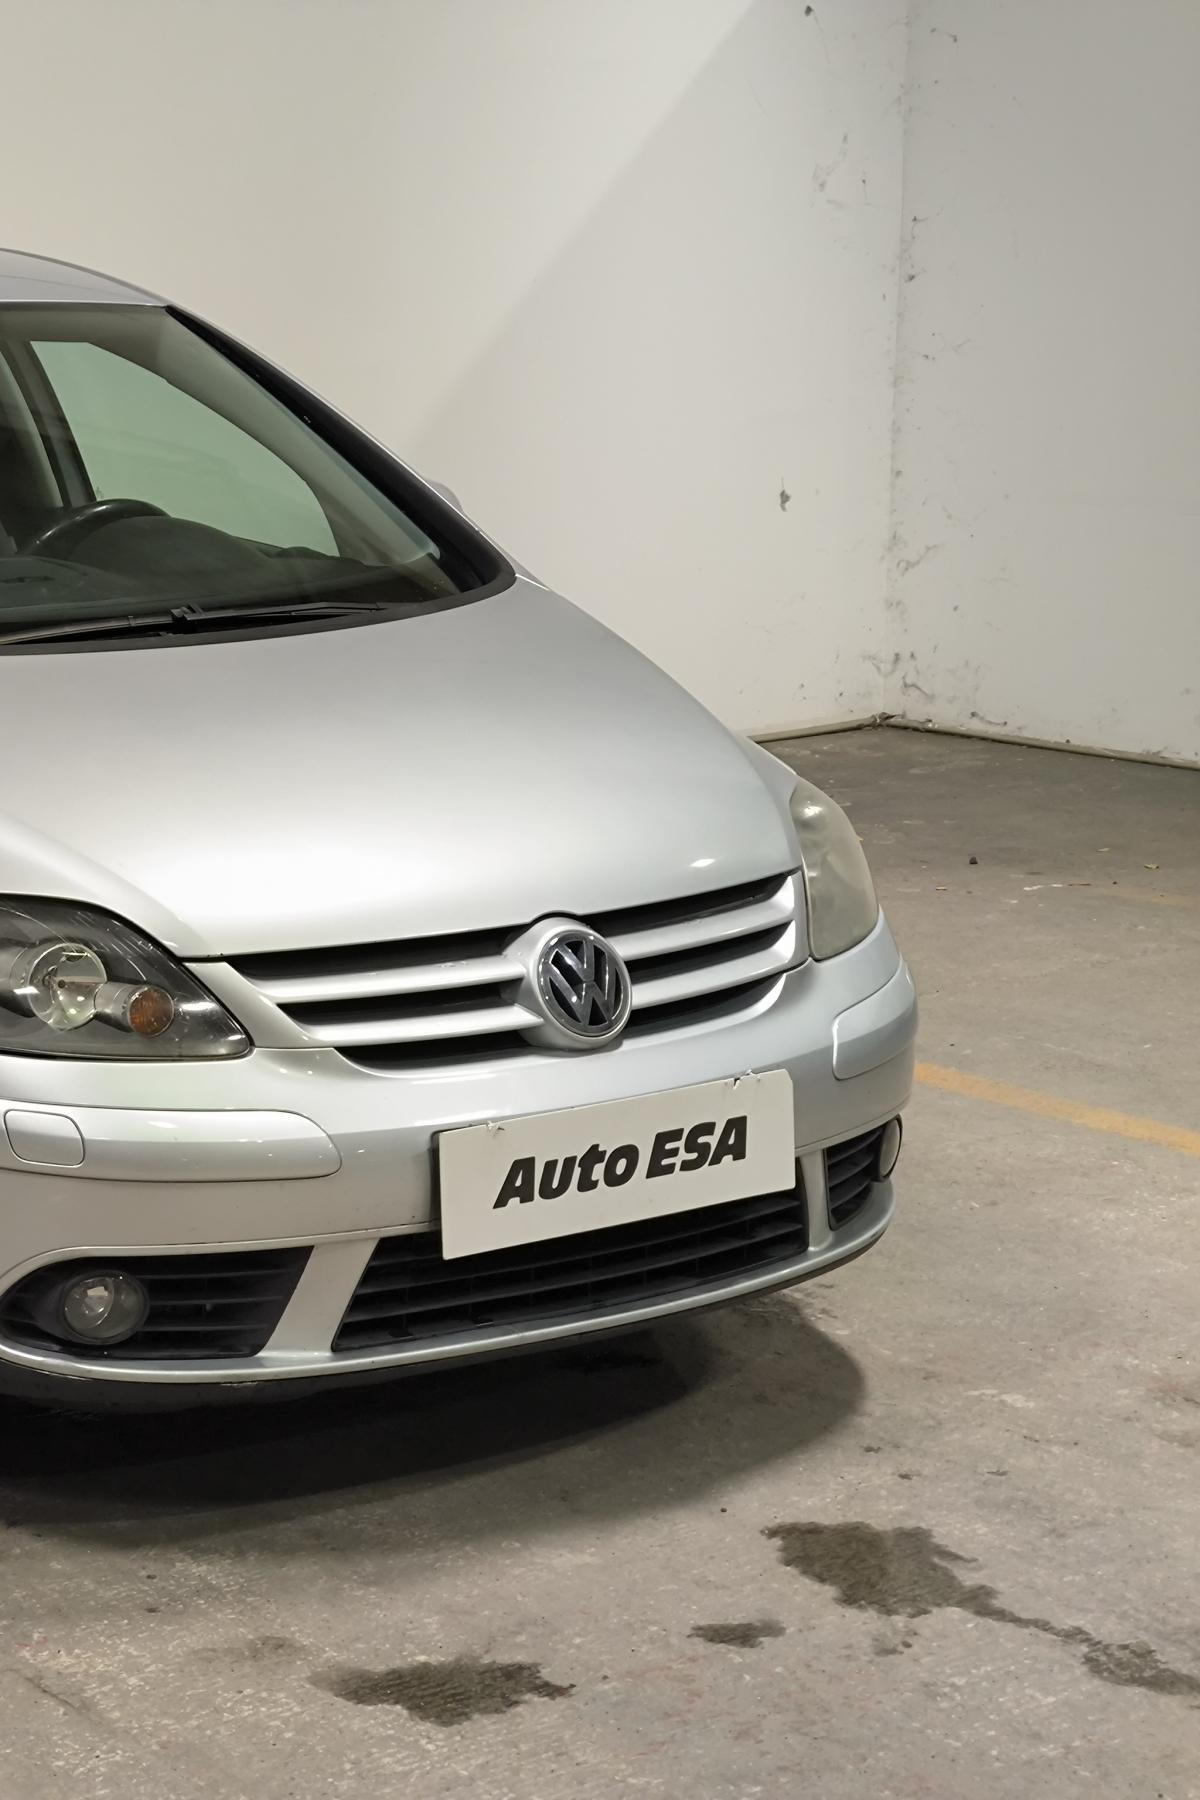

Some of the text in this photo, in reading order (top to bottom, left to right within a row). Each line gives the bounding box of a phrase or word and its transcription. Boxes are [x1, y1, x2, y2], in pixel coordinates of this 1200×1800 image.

[539, 931, 628, 1035] VW
[493, 1115, 748, 1209] Auto ESA
